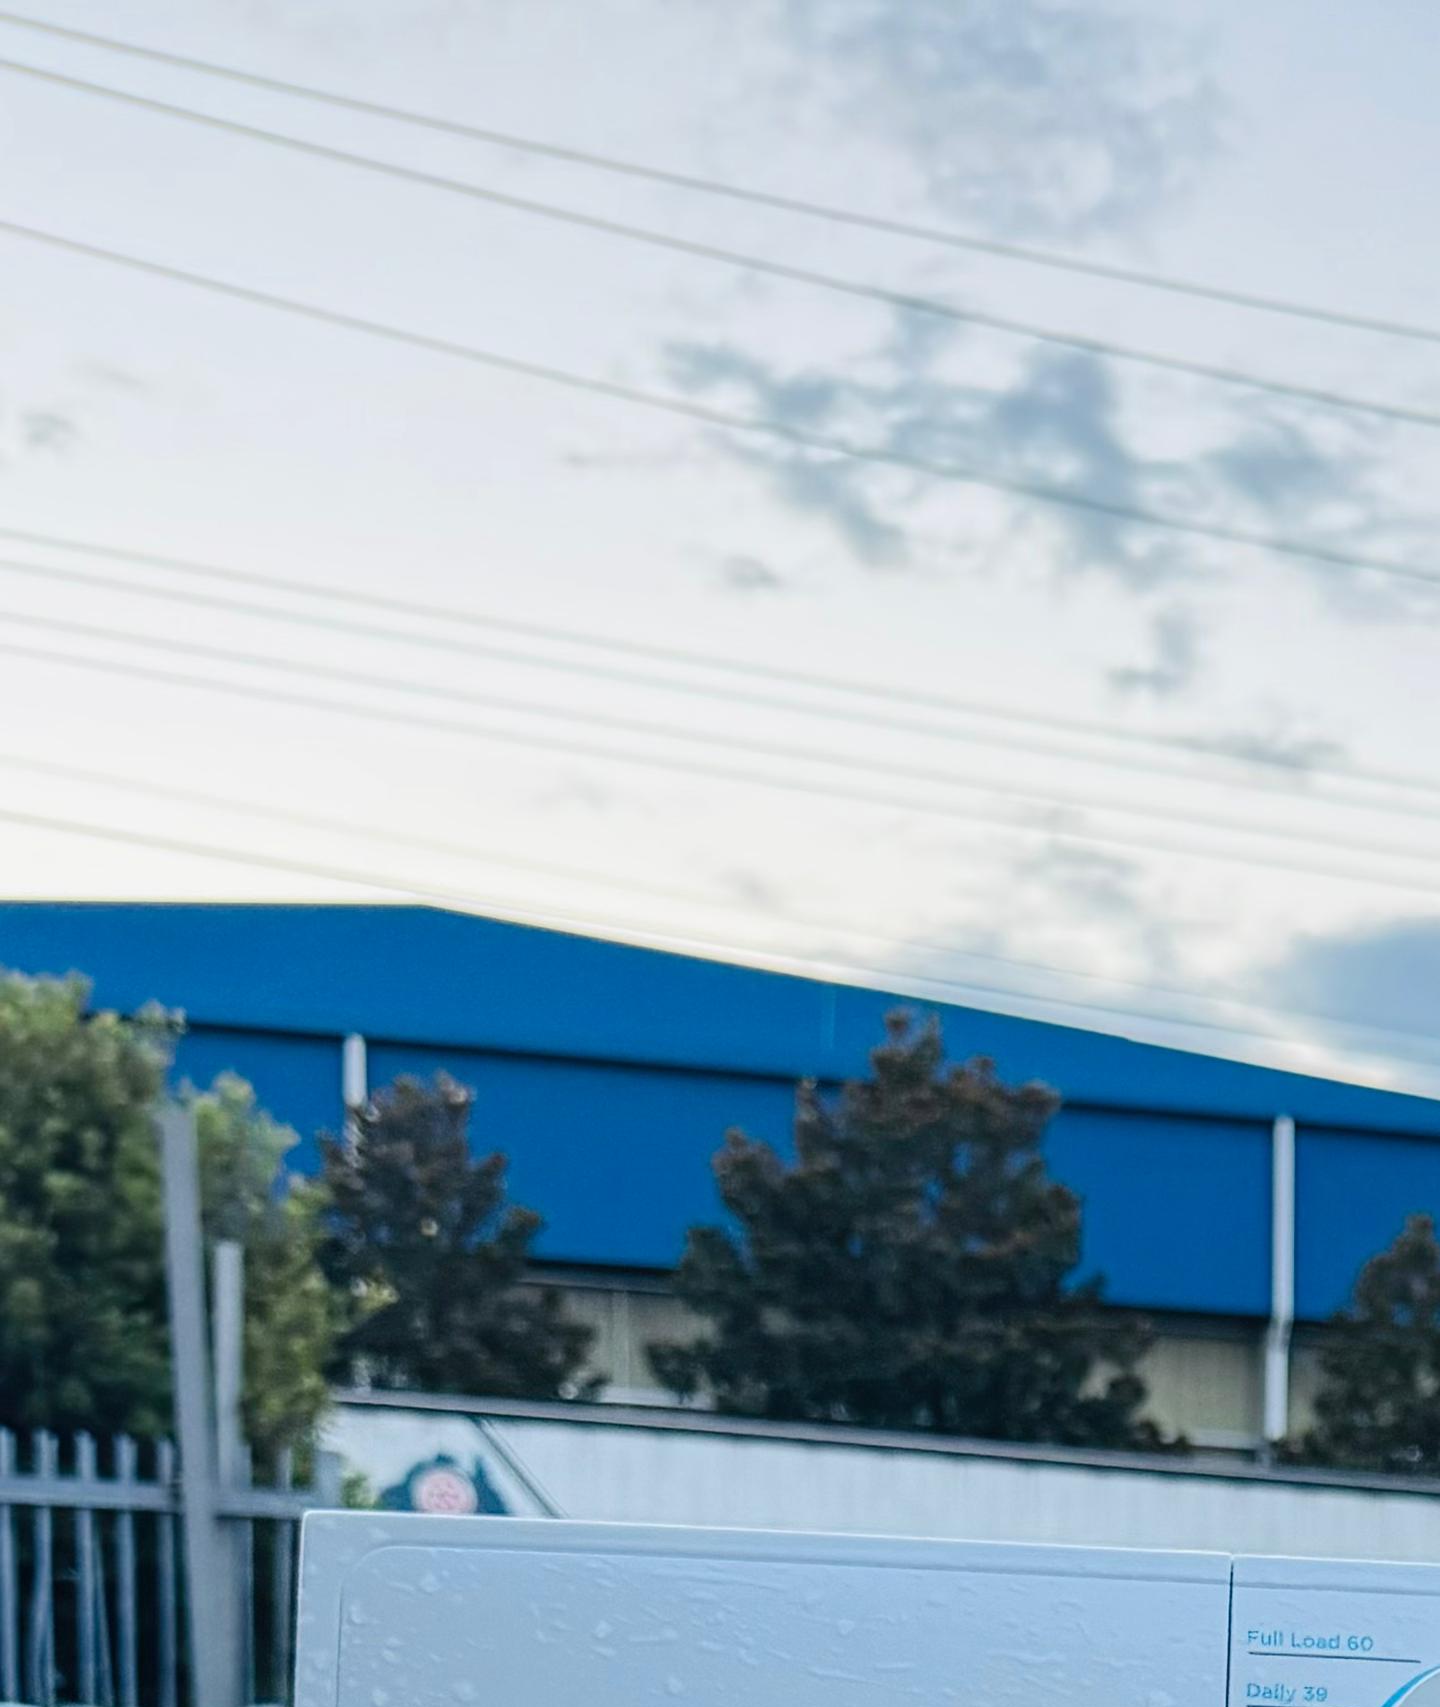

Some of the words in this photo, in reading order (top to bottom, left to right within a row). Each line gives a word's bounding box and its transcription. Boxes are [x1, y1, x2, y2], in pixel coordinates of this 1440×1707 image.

[1247, 1630, 1283, 1647] Full
[1291, 1632, 1340, 1649] Load
[1347, 1636, 1374, 1651] 60
[1246, 1683, 1296, 1704] Daily
[1304, 1686, 1328, 1702] 39
